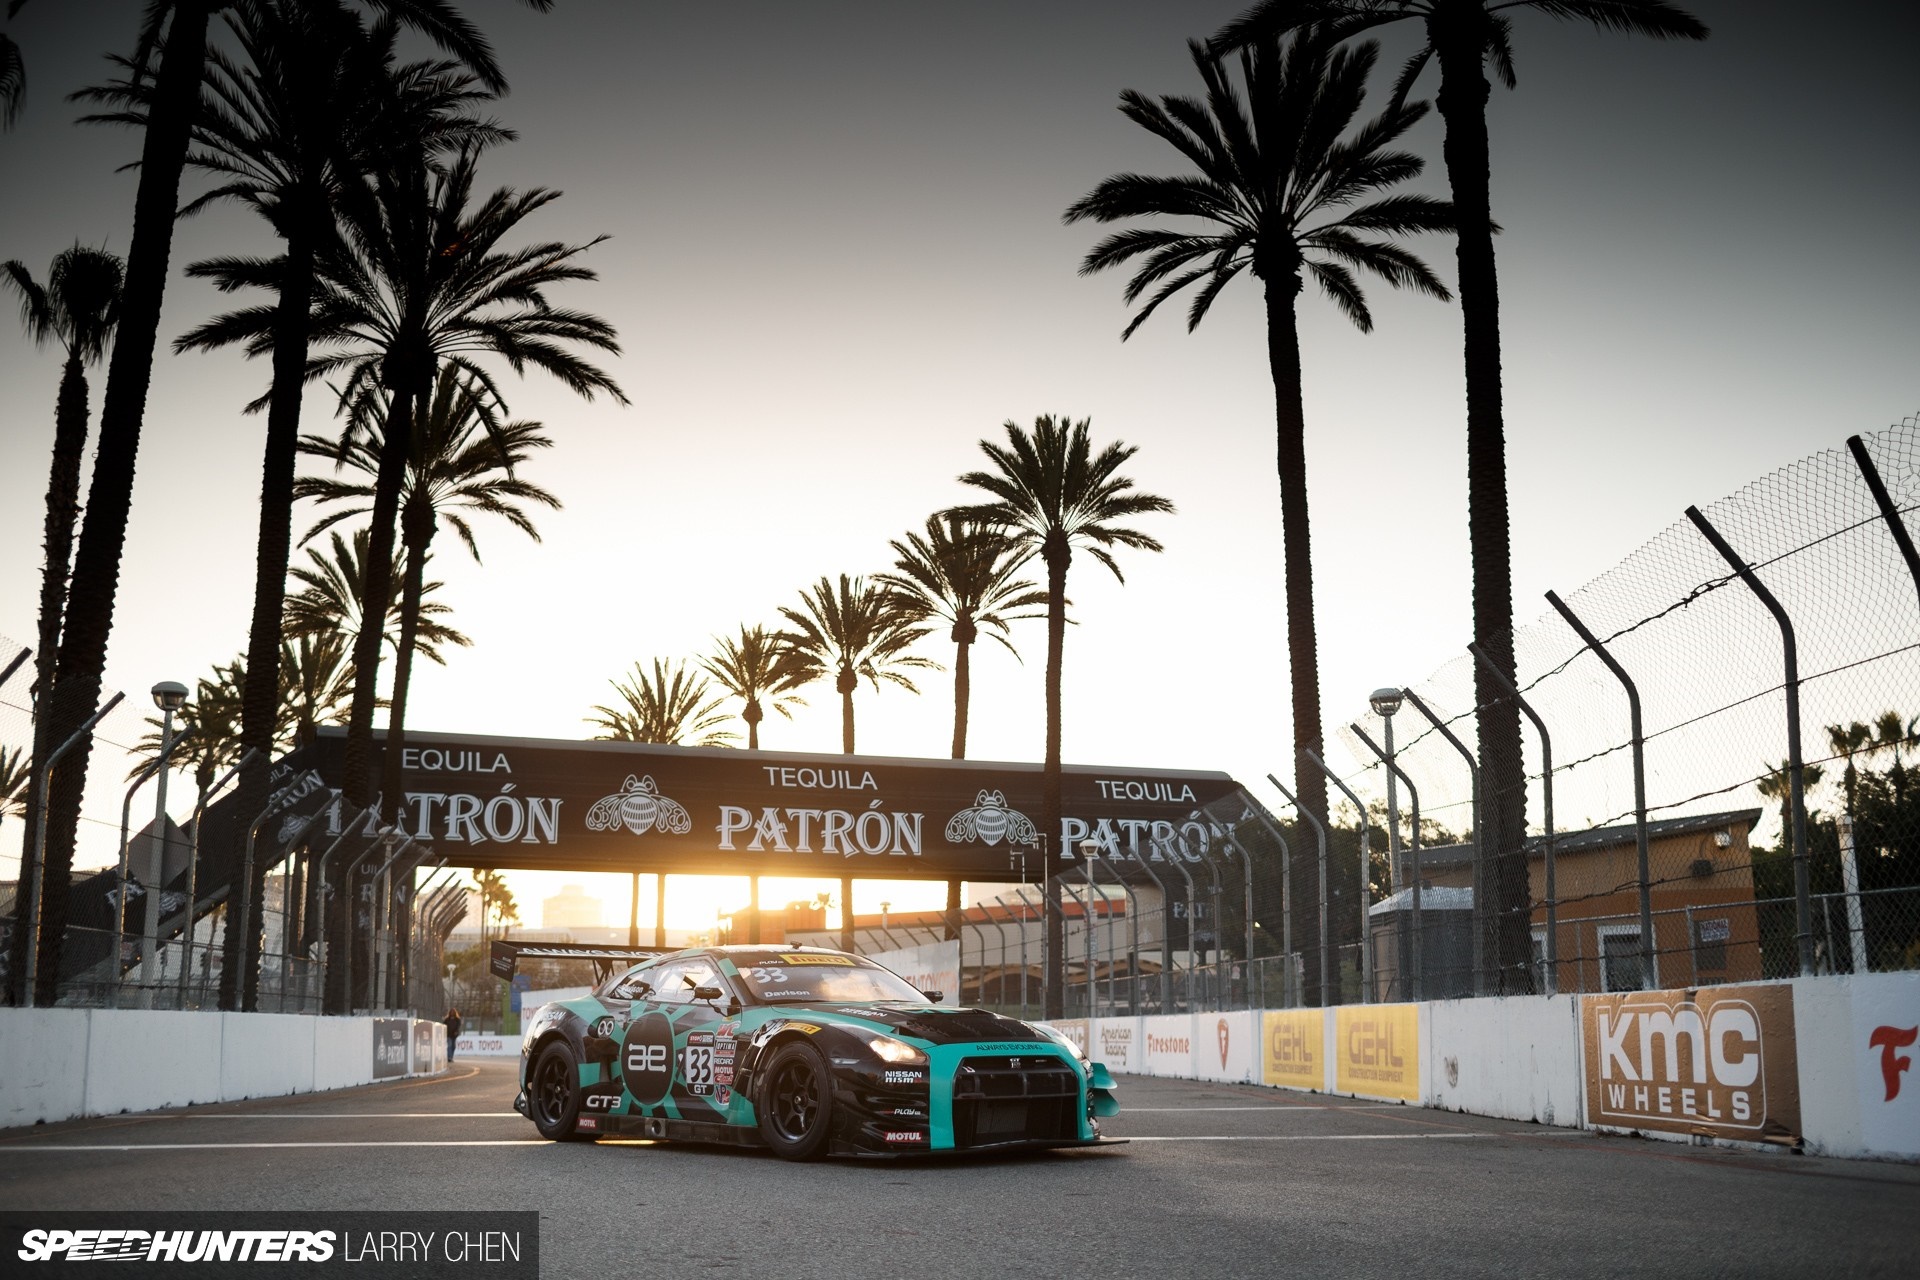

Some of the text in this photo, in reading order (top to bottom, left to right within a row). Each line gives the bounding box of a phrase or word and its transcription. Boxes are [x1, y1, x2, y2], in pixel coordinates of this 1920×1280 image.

[383, 748, 512, 773] EQUILA
[763, 766, 878, 790] TEQUILA
[1095, 780, 1197, 802] TEQUILA
[715, 799, 925, 858] PATRÓN
[751, 967, 788, 983] 33
[764, 990, 810, 998] Davison
[1100, 1024, 1132, 1042] American
[1272, 1023, 1313, 1062] GEHL
[456, 1040, 503, 1050] YOTA TOYOTA
[1147, 1033, 1190, 1056] Firestone
[1348, 1021, 1404, 1068] GEHL
[691, 1048, 711, 1083] 33
[714, 1066, 734, 1074] MOTUL
[694, 1084, 707, 1094] GT
[586, 1095, 621, 1108] GT3
[1608, 1083, 1750, 1120] WHEELS
[579, 1118, 596, 1127] MOTUL
[886, 1132, 922, 1141] MOTUL
